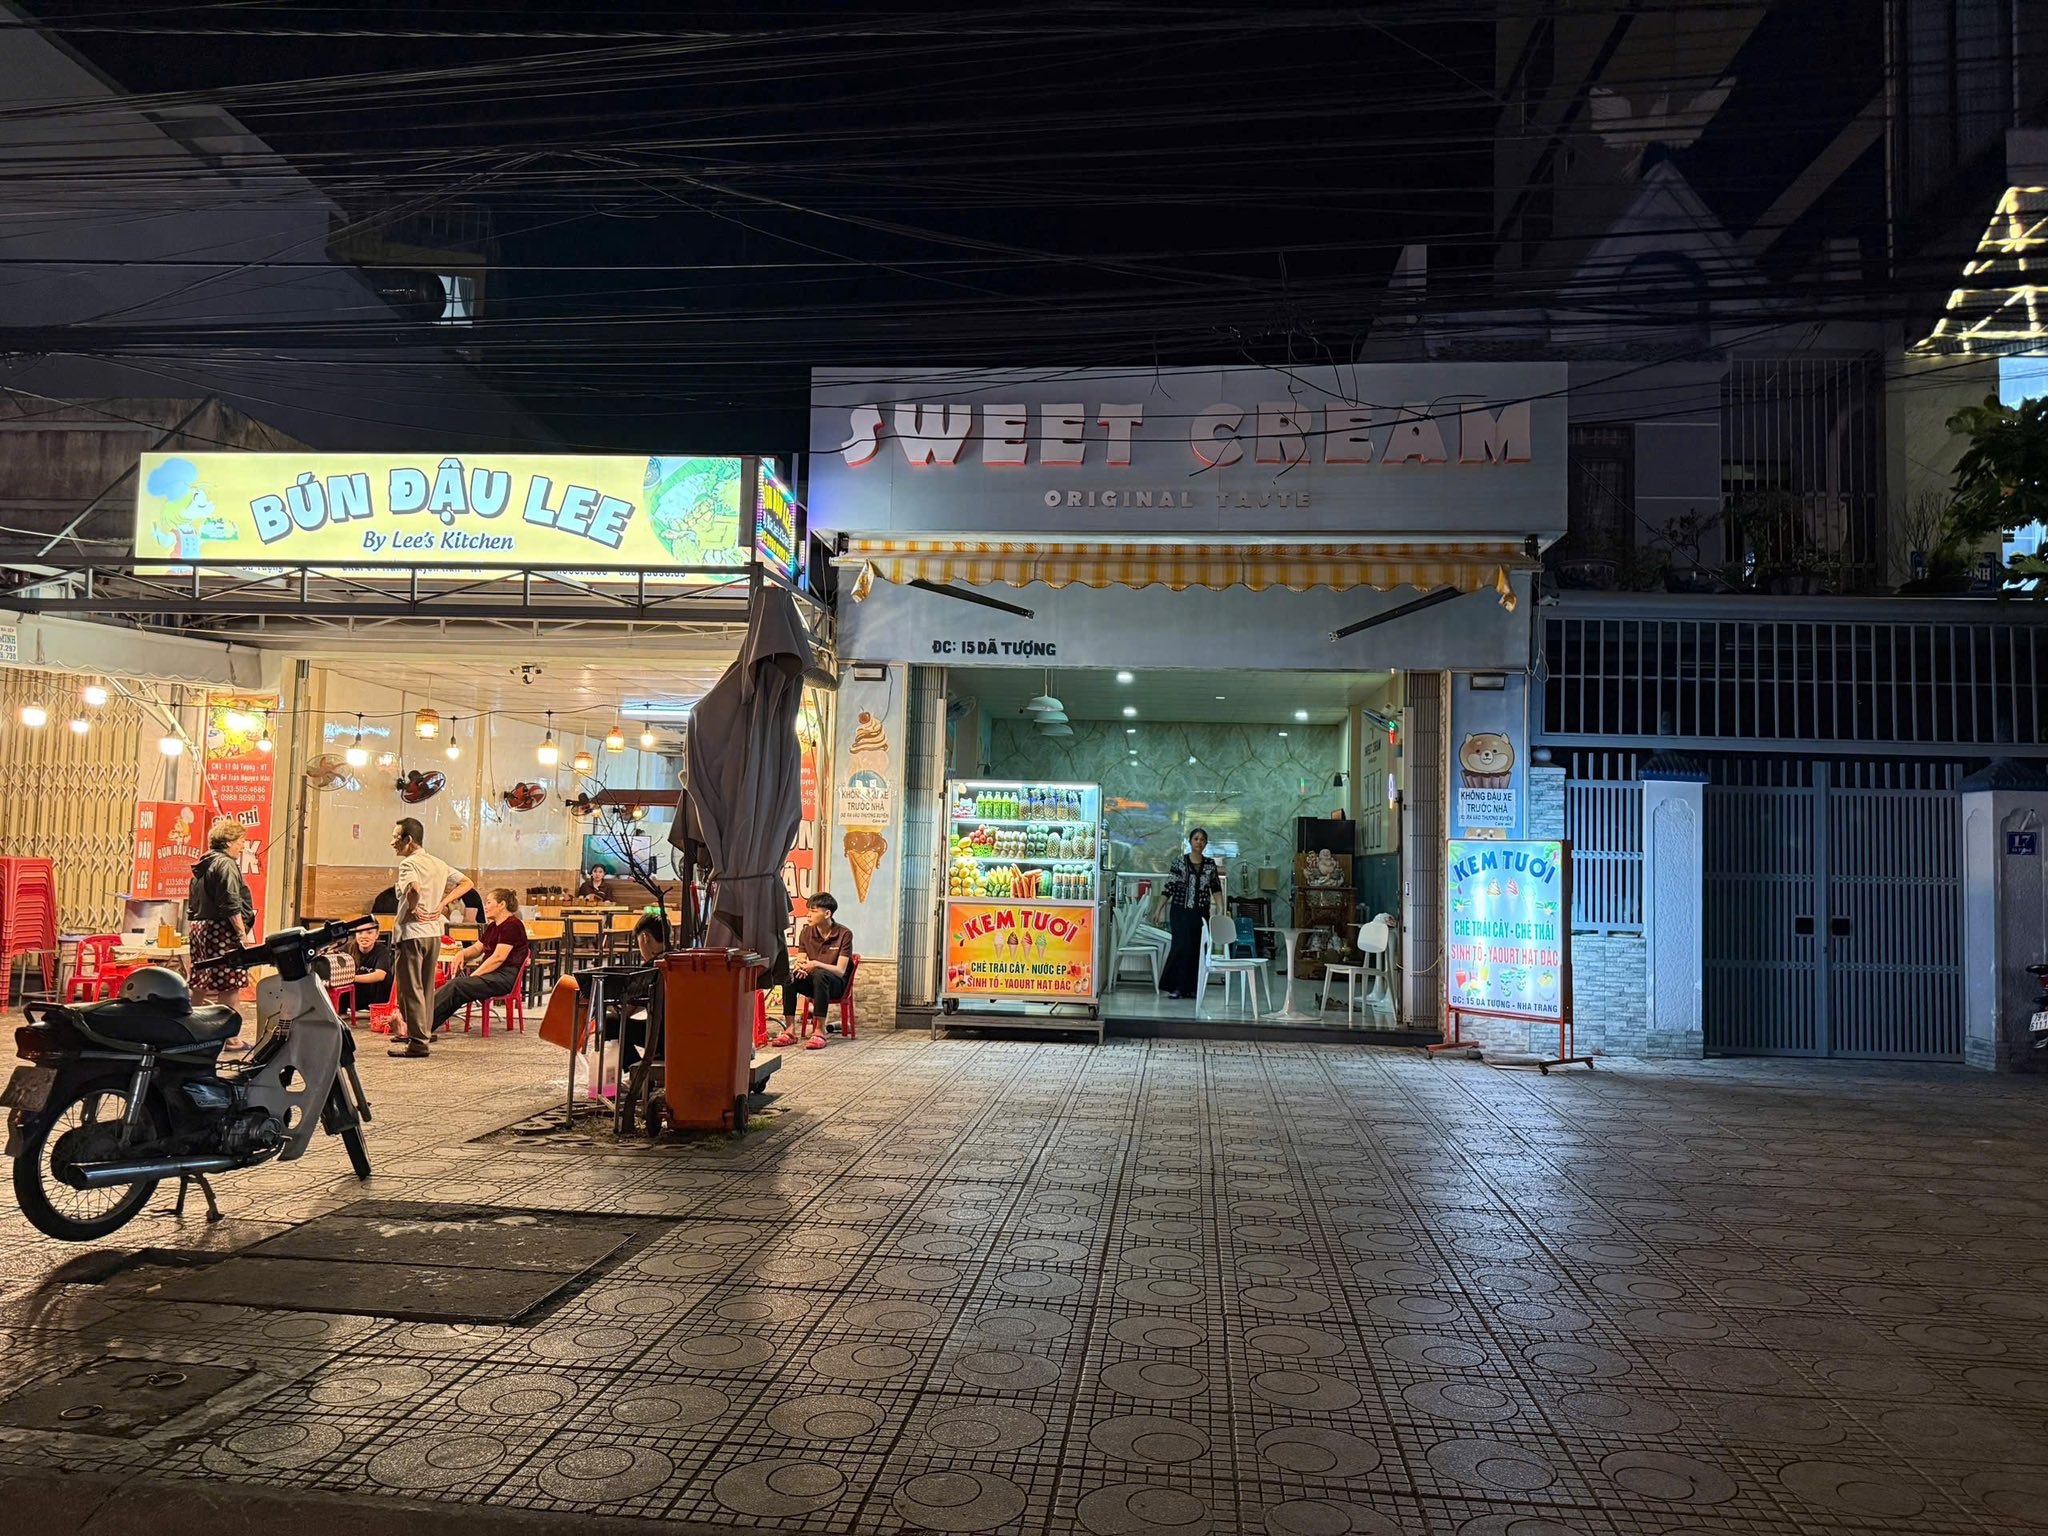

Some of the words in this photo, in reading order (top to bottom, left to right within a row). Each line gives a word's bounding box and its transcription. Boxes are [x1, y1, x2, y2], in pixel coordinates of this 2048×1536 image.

[841, 403, 1144, 466] SWEET
[1190, 400, 1532, 467] CREAM
[250, 472, 374, 545] BÚN
[389, 457, 512, 526] ĐẬU
[522, 475, 636, 550] LEE
[1044, 490, 1194, 508] ORIGINAL
[1216, 491, 1312, 509] TASTE
[363, 531, 386, 551] By
[393, 531, 435, 549] Lee's
[441, 531, 514, 549] Kitchen
[931, 641, 957, 654] ĐC:
[977, 638, 999, 655] DÃ
[1001, 641, 1057, 658] TƯỢNG
[1461, 790, 1485, 801] KHÔNG
[1503, 793, 1512, 801] XE
[2014, 835, 2031, 847] 17
[188, 846, 200, 859] LEE
[1453, 851, 1498, 881] KEM
[1503, 851, 1556, 884] TƯƠI
[137, 871, 149, 889] LEE
[963, 910, 1015, 940] KEM
[1020, 910, 1080, 944] TƯƠI
[1455, 917, 1470, 936] CHÈ
[1534, 920, 1554, 940] THÁI
[1451, 944, 1470, 960] SINH
[1489, 946, 1519, 964] YAOURT
[971, 961, 986, 972] CHÈ
[1005, 978, 1034, 989] YAOURT
[1037, 979, 1053, 991] HẠT
[1517, 1002, 1532, 1011] NHA
[1534, 1003, 1558, 1013] TRANG
